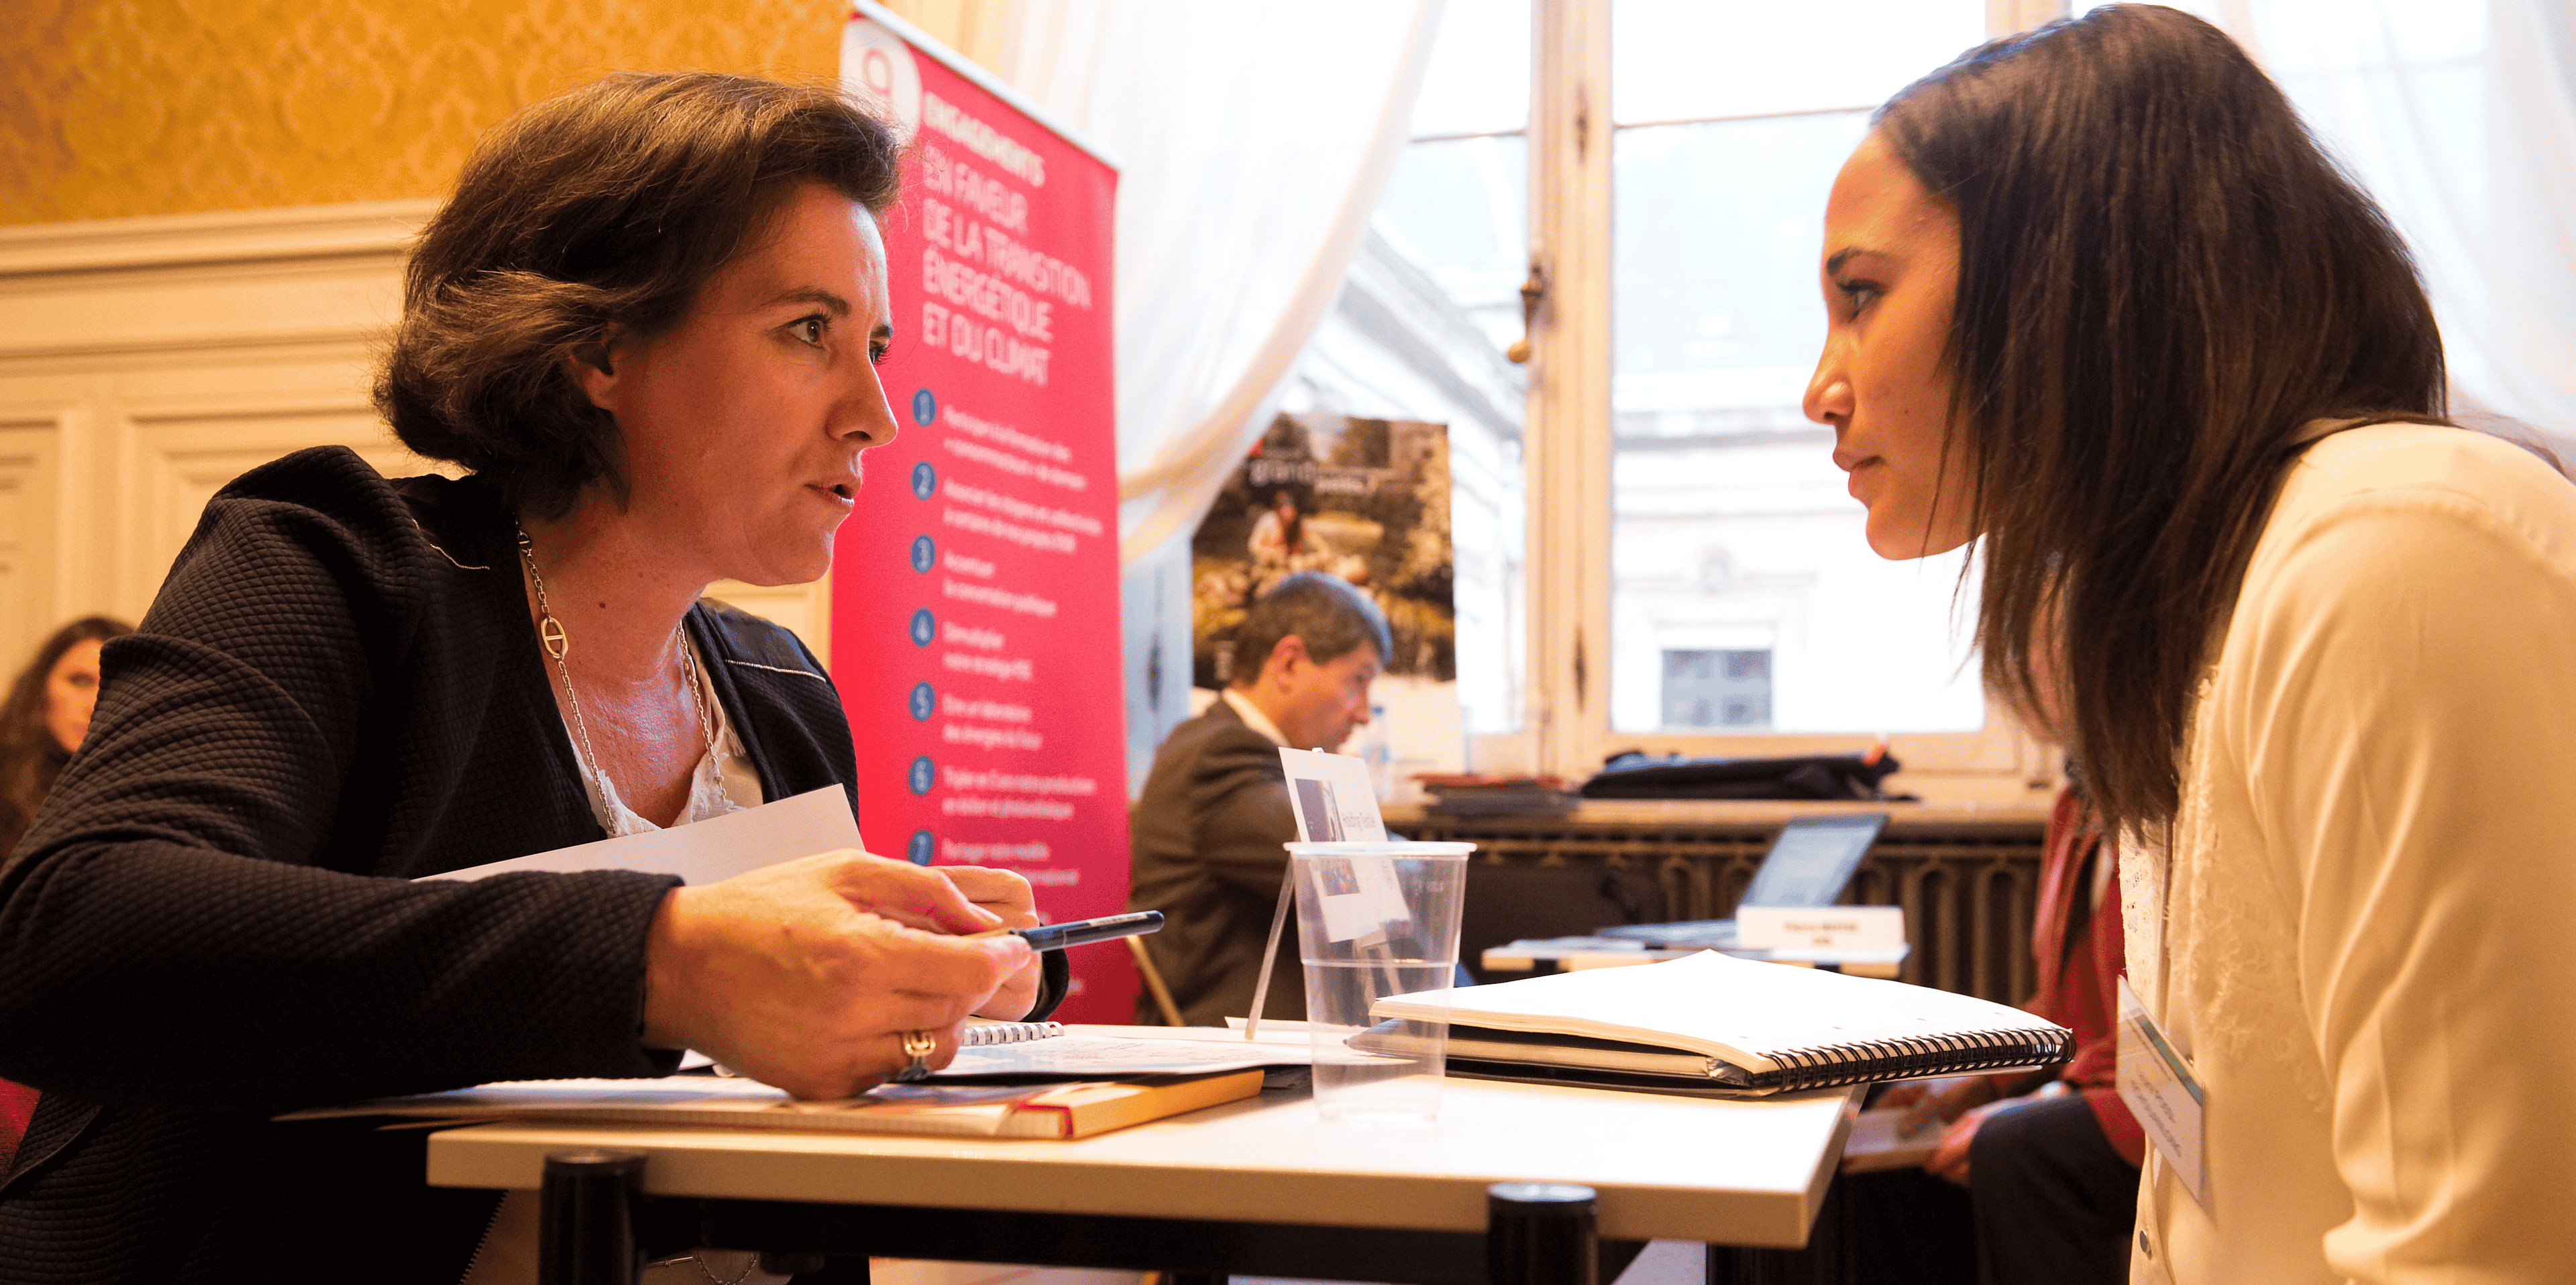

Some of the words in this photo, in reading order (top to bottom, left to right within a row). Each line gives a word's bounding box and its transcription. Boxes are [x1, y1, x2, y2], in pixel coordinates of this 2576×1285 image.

[923, 91, 1044, 187] ENGAGEMENTS
[955, 161, 1028, 235] FAVEUR
[923, 198, 951, 248] DE
[953, 212, 983, 262] LA
[983, 224, 1092, 310] TRANSITION
[923, 243, 1054, 342] ÉNERGÉTIQUE
[923, 300, 949, 347] ET
[951, 313, 983, 363] DU
[984, 327, 1053, 386] CLIMAT
